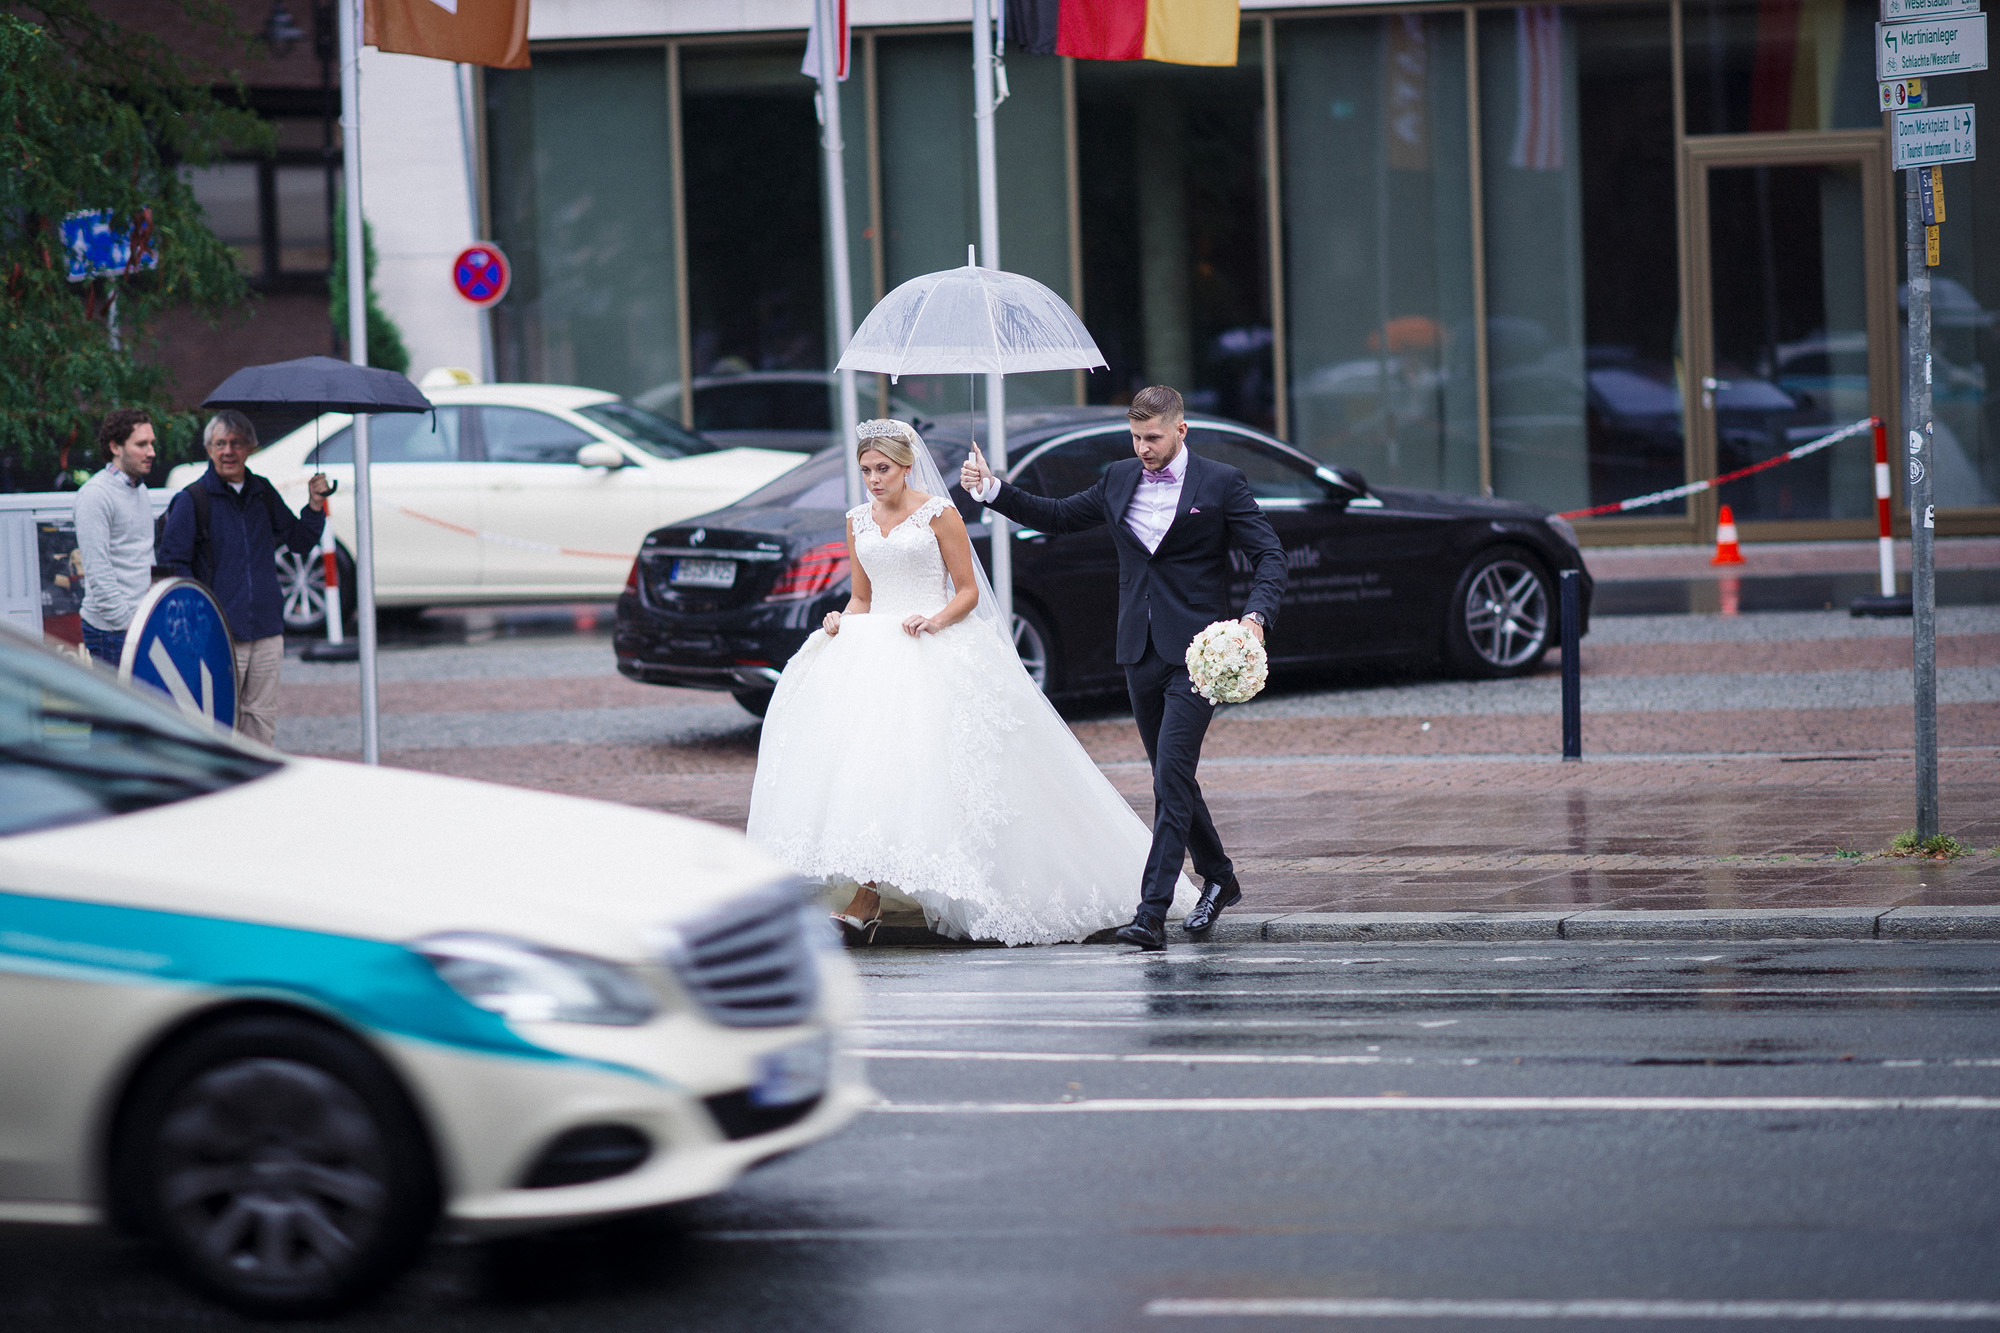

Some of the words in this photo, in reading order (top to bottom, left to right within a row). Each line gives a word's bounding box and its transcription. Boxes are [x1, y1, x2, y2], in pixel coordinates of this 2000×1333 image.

[1901, 28, 1958, 46] Martinianleger
[1901, 51, 1961, 69] Schlachte/Weserufer
[1899, 117, 1949, 137] Dom/Marktplatz
[1907, 142, 1923, 159] Tourist
[1924, 140, 1951, 157] Information
